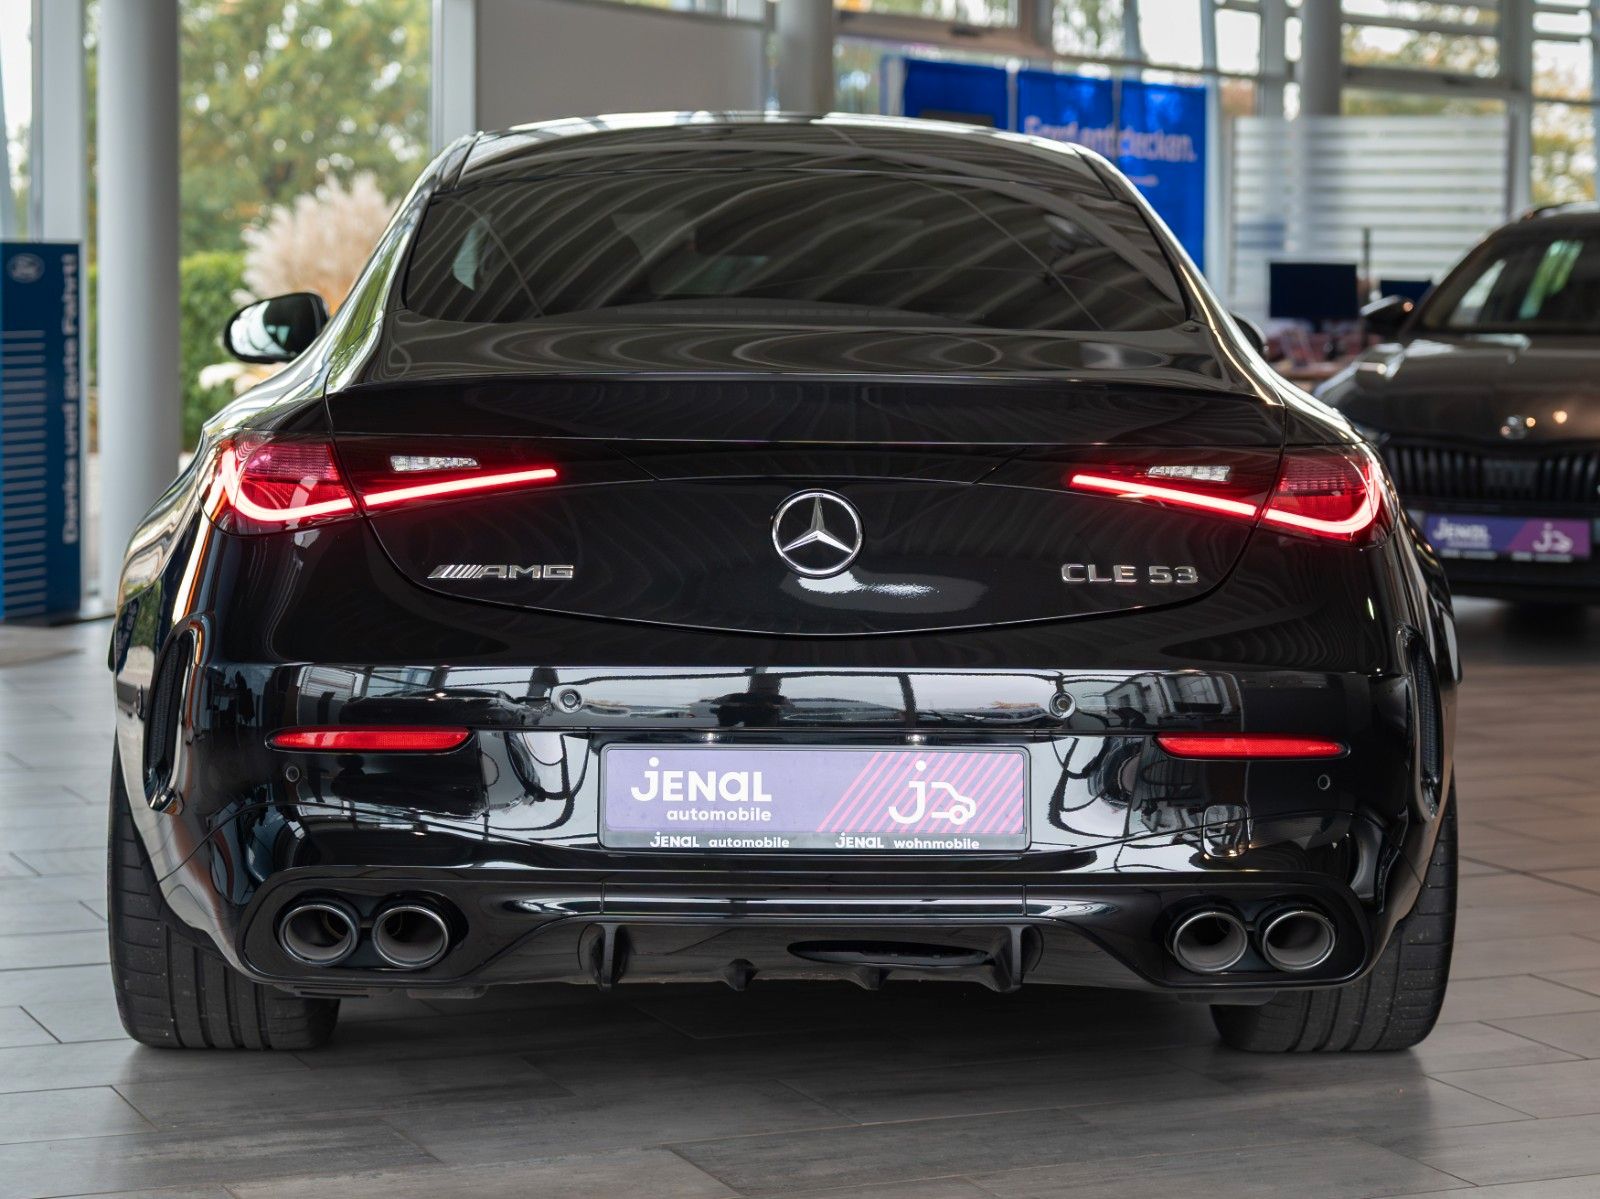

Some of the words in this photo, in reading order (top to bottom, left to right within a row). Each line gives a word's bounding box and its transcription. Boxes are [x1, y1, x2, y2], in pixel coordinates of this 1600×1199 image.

[62, 404, 78, 455] und
[473, 564, 574, 579] AMG
[1060, 563, 1138, 584] CLE
[1148, 565, 1199, 584] 53
[666, 806, 772, 822] automobile
[708, 836, 790, 848] automobile
[893, 836, 980, 850] wohnmobile
